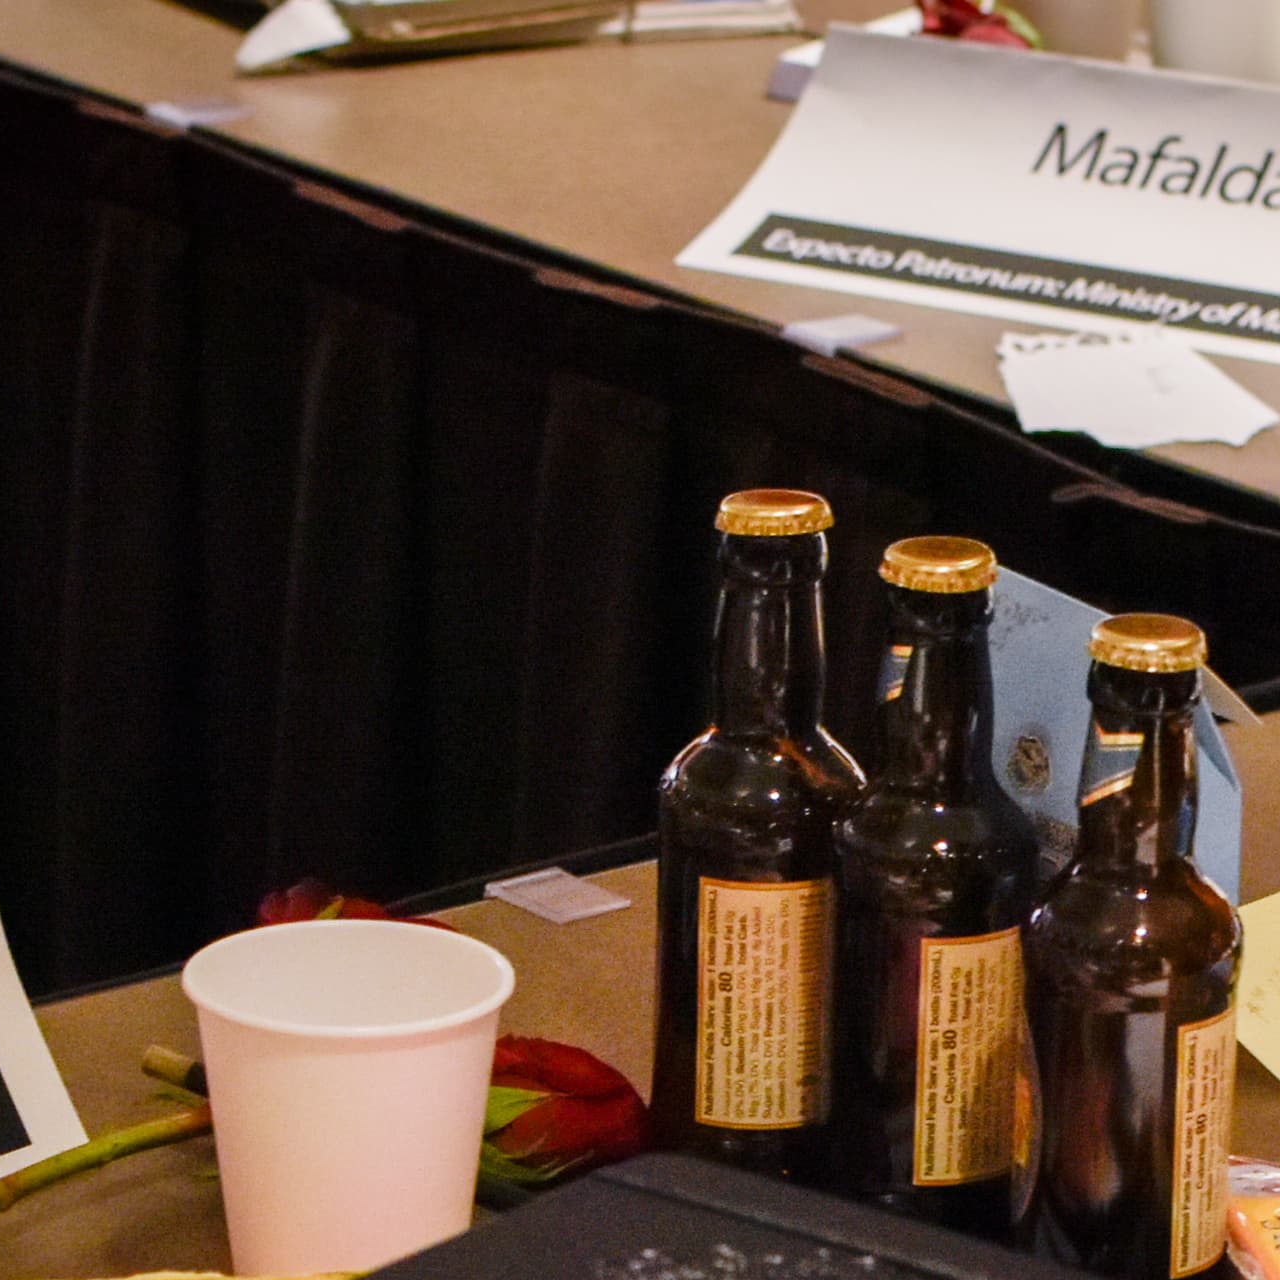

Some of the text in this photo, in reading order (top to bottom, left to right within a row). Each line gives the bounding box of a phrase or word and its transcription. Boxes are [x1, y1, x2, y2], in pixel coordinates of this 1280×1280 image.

[762, 227, 895, 269] Expecto
[894, 249, 1066, 299] Patronum:
[1065, 277, 1202, 323] Ministry
[1199, 302, 1247, 325] of
[720, 997, 731, 1046] Calories
[943, 1053, 956, 1104] Calories
